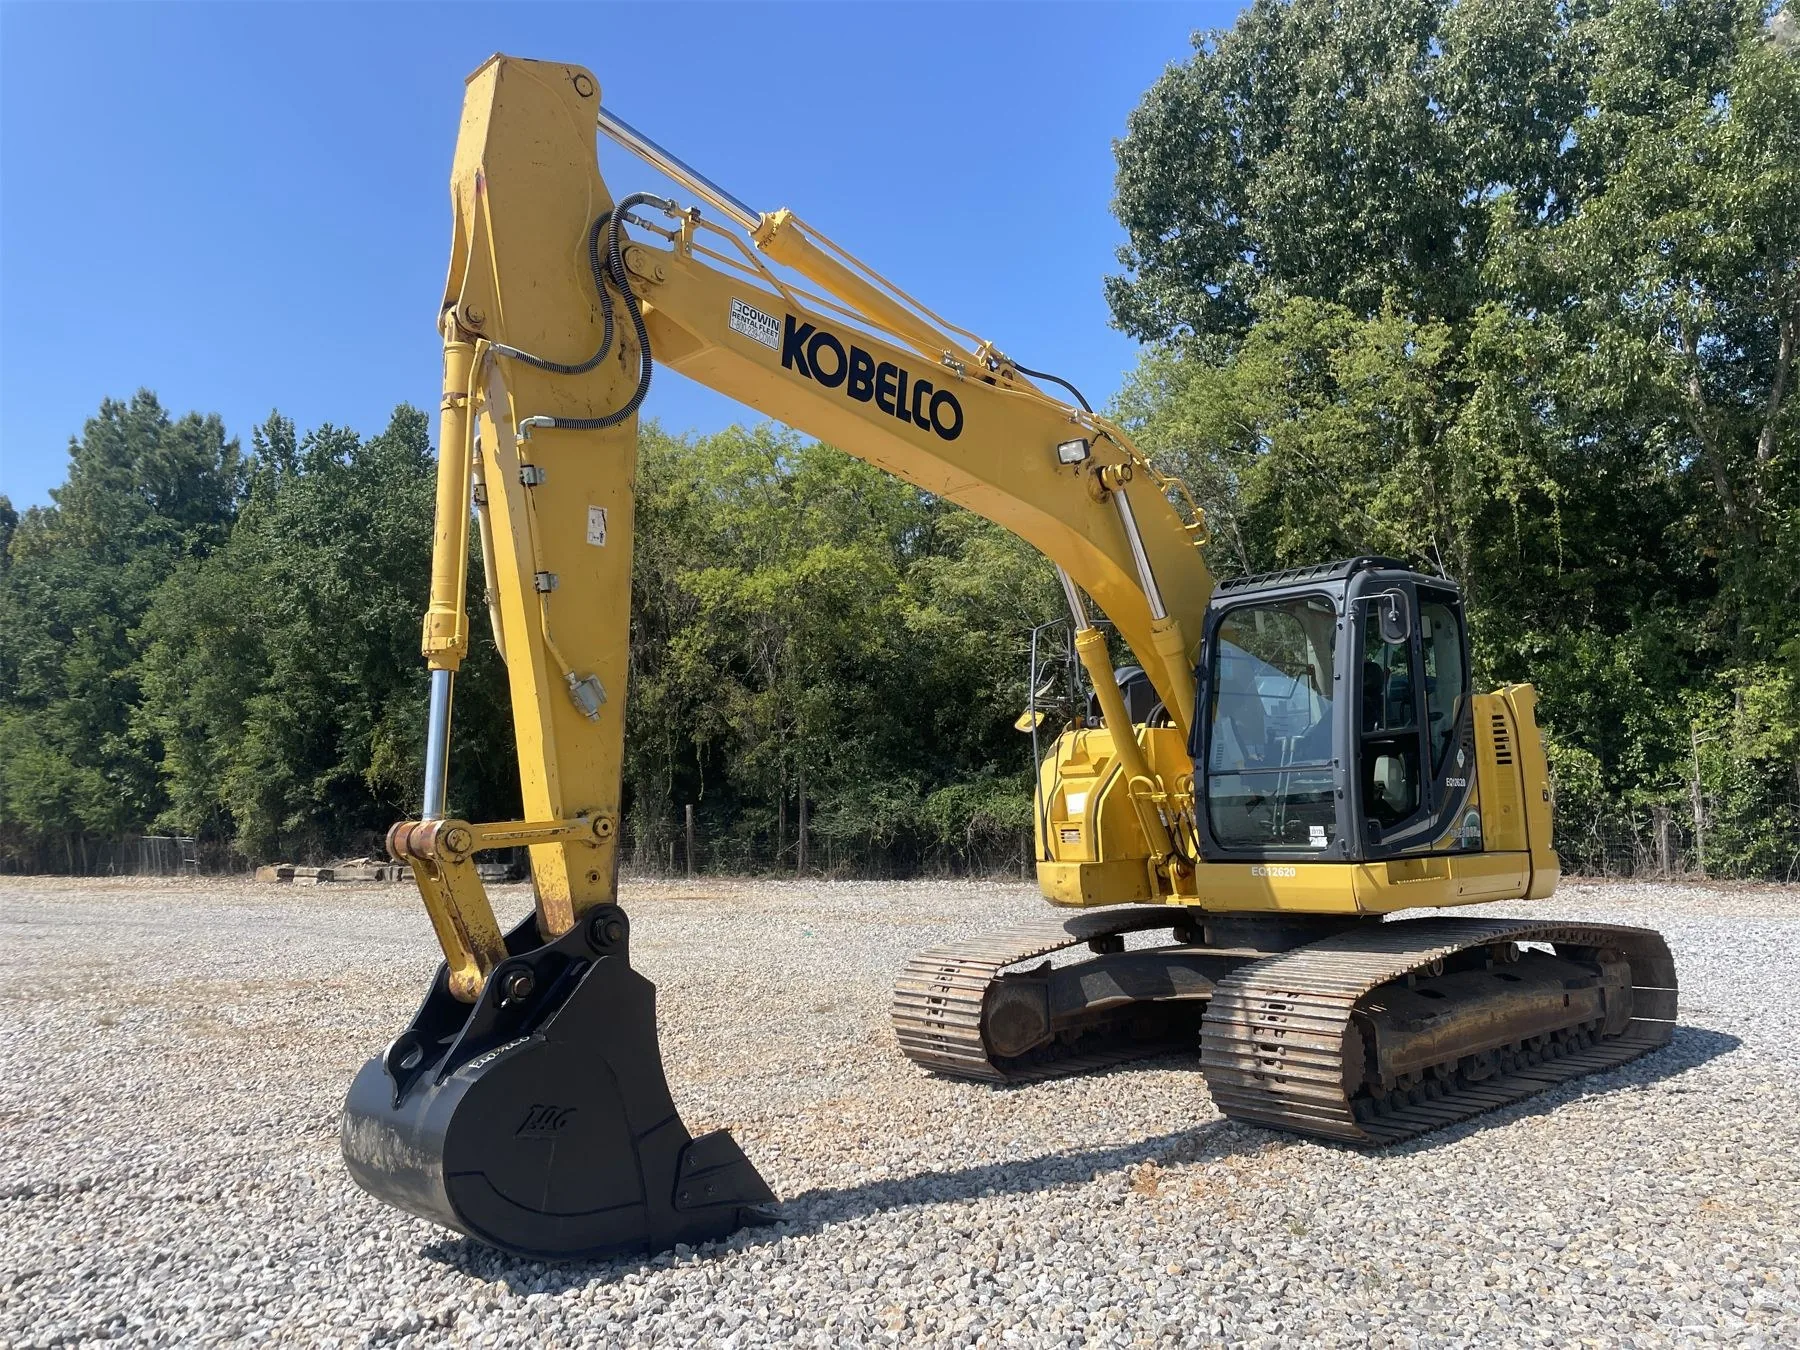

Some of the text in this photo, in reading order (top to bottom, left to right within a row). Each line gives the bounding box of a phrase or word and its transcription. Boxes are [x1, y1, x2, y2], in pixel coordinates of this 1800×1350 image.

[732, 311, 779, 338] RENTAL FLEET
[742, 305, 780, 332] COWIN
[781, 313, 964, 441] KOBELCO
[1251, 866, 1296, 877] EQ12620
